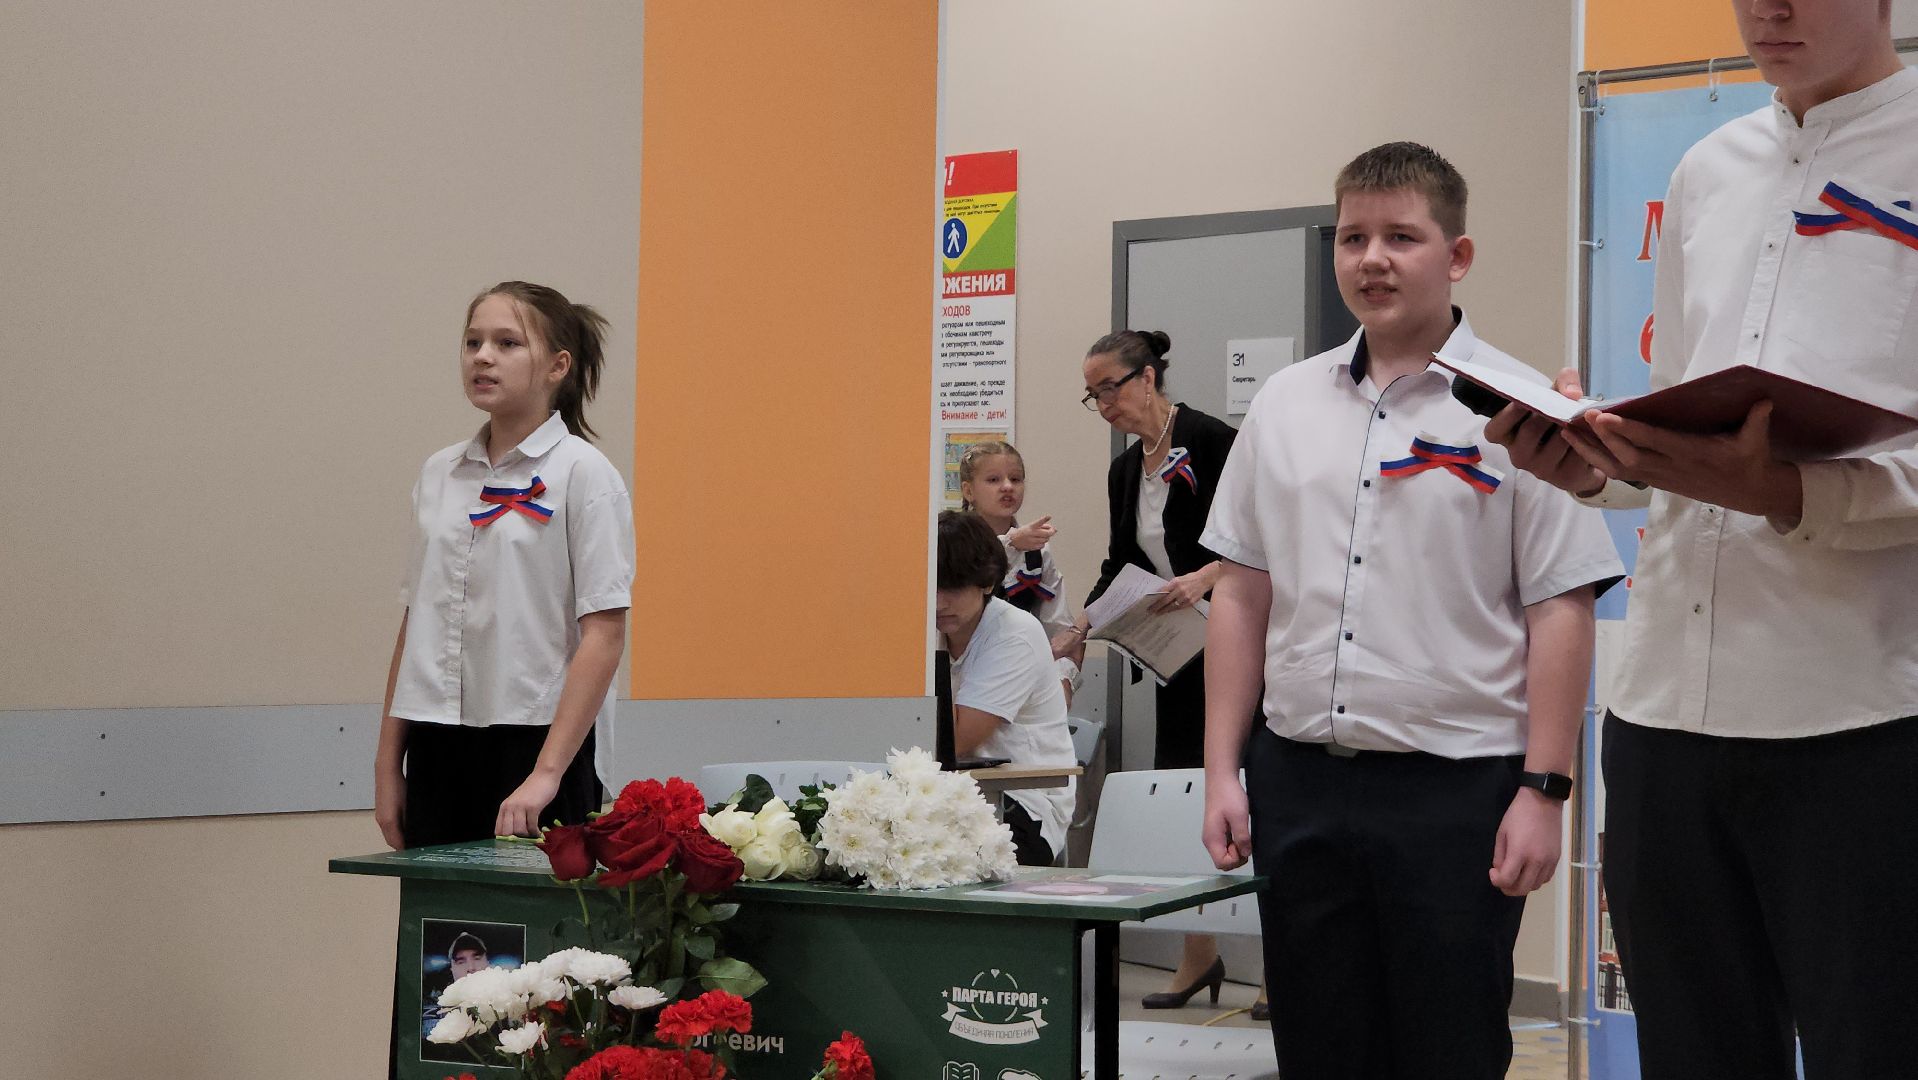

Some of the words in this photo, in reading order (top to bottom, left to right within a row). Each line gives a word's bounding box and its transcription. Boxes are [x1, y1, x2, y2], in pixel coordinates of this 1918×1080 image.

[1232, 353, 1245, 367] 31
[941, 410, 978, 421] Внимание
[986, 409, 1007, 421] дети!
[952, 986, 995, 1005] ПАРТА
[996, 991, 1038, 1008] ГЕРОЯ
